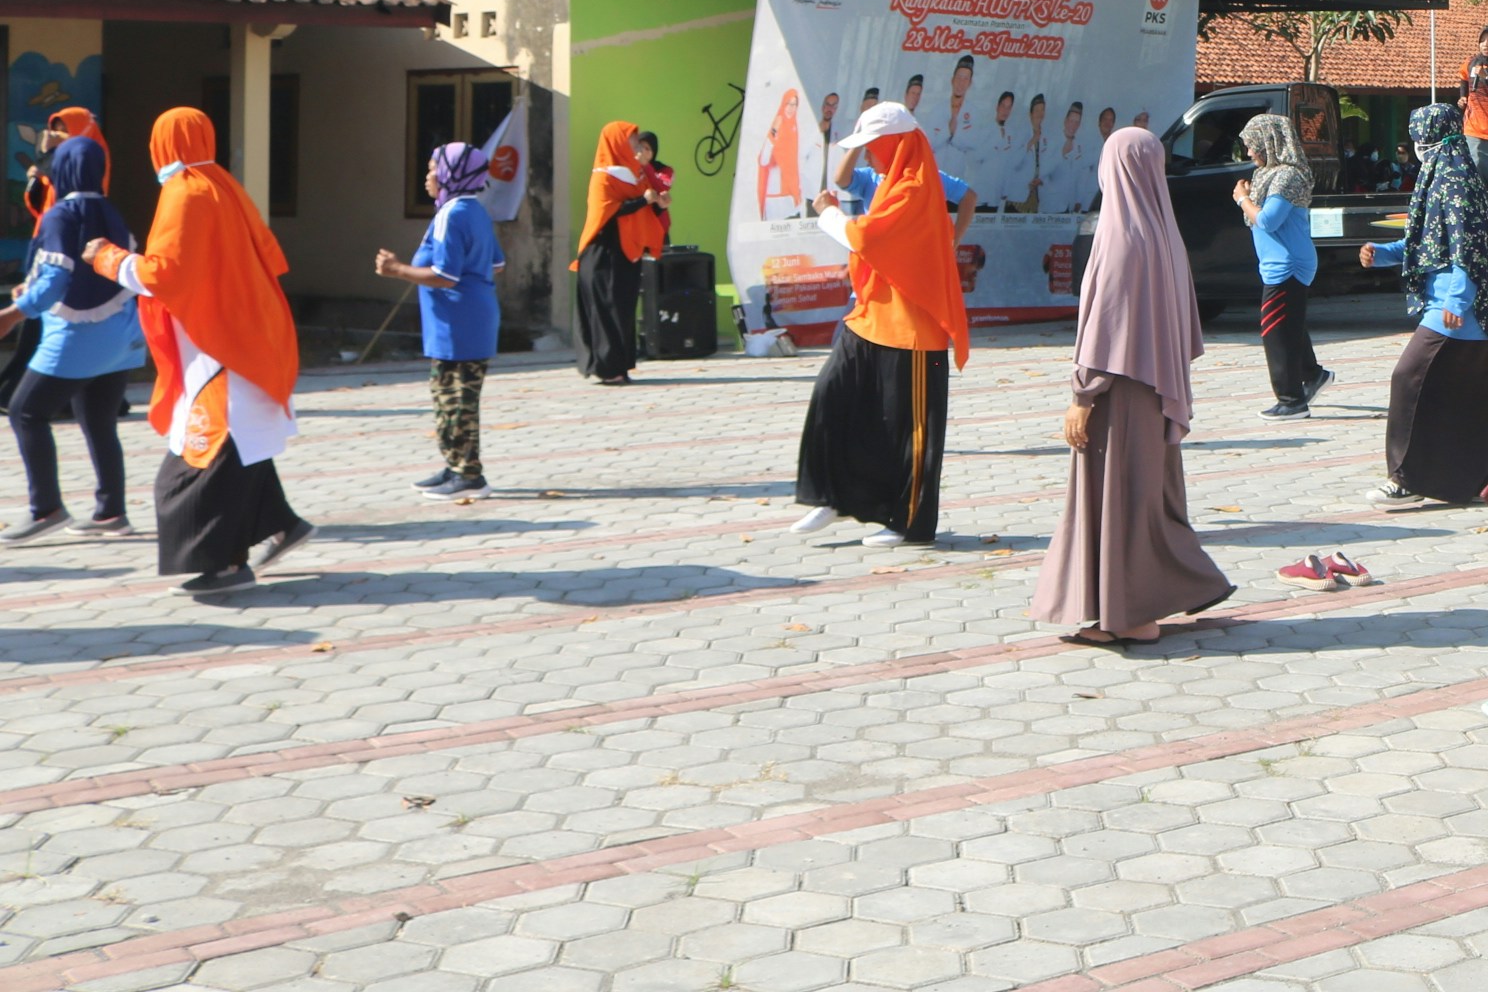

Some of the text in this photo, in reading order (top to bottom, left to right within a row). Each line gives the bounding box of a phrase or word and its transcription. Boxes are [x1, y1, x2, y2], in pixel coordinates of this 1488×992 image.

[953, 18, 989, 27] Kecamatan
[1144, 11, 1166, 24] PKS
[905, 30, 925, 48] 28
[925, 30, 960, 50] Mei
[974, 35, 994, 52] 26
[993, 34, 1026, 56] Juni
[1028, 39, 1062, 56] 2022
[782, 256, 800, 267] Juni
